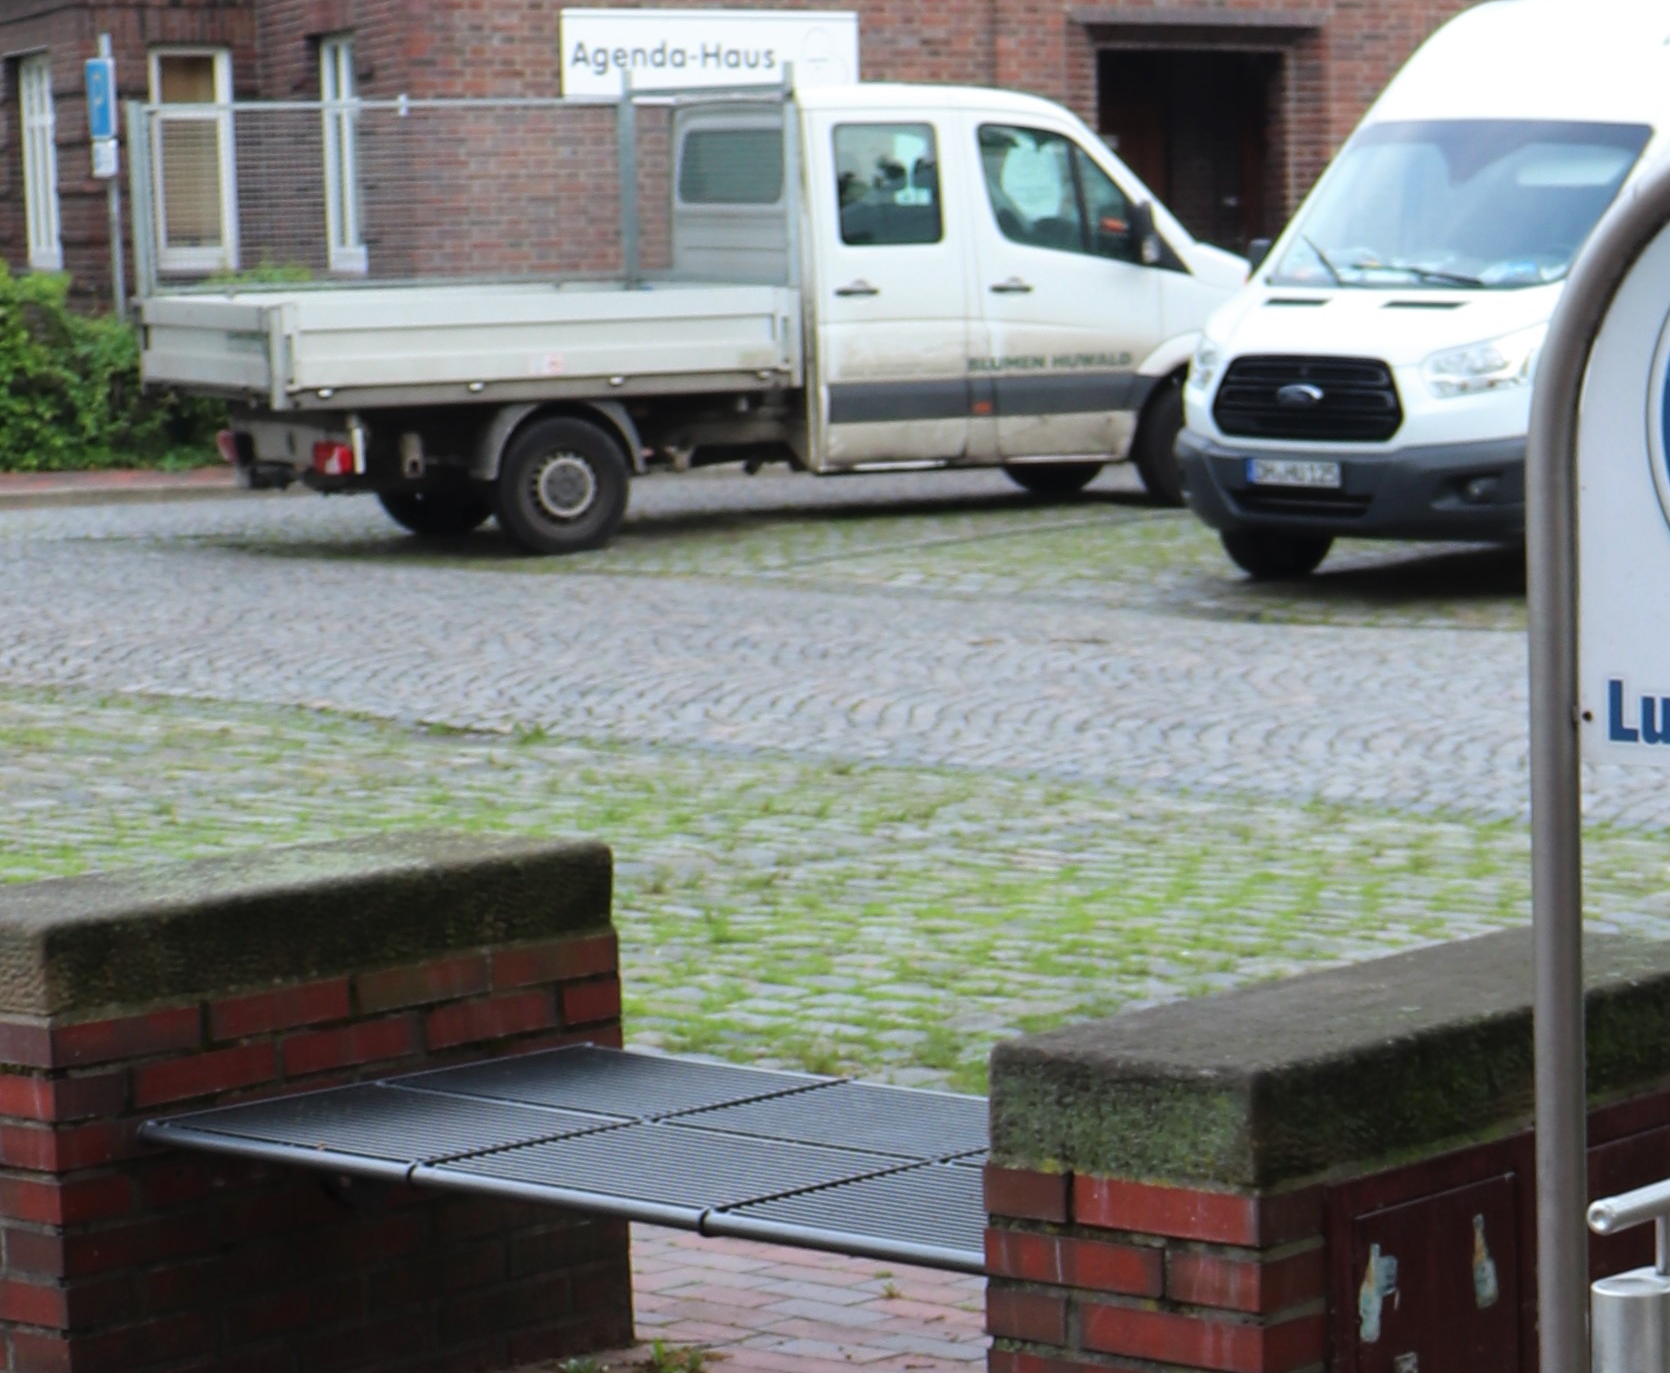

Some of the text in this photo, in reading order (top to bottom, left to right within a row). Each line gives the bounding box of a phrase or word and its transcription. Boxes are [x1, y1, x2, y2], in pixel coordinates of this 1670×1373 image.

[571, 39, 776, 75] Agenda-Haus
[967, 352, 1133, 372] BLUMEN HUWALD
